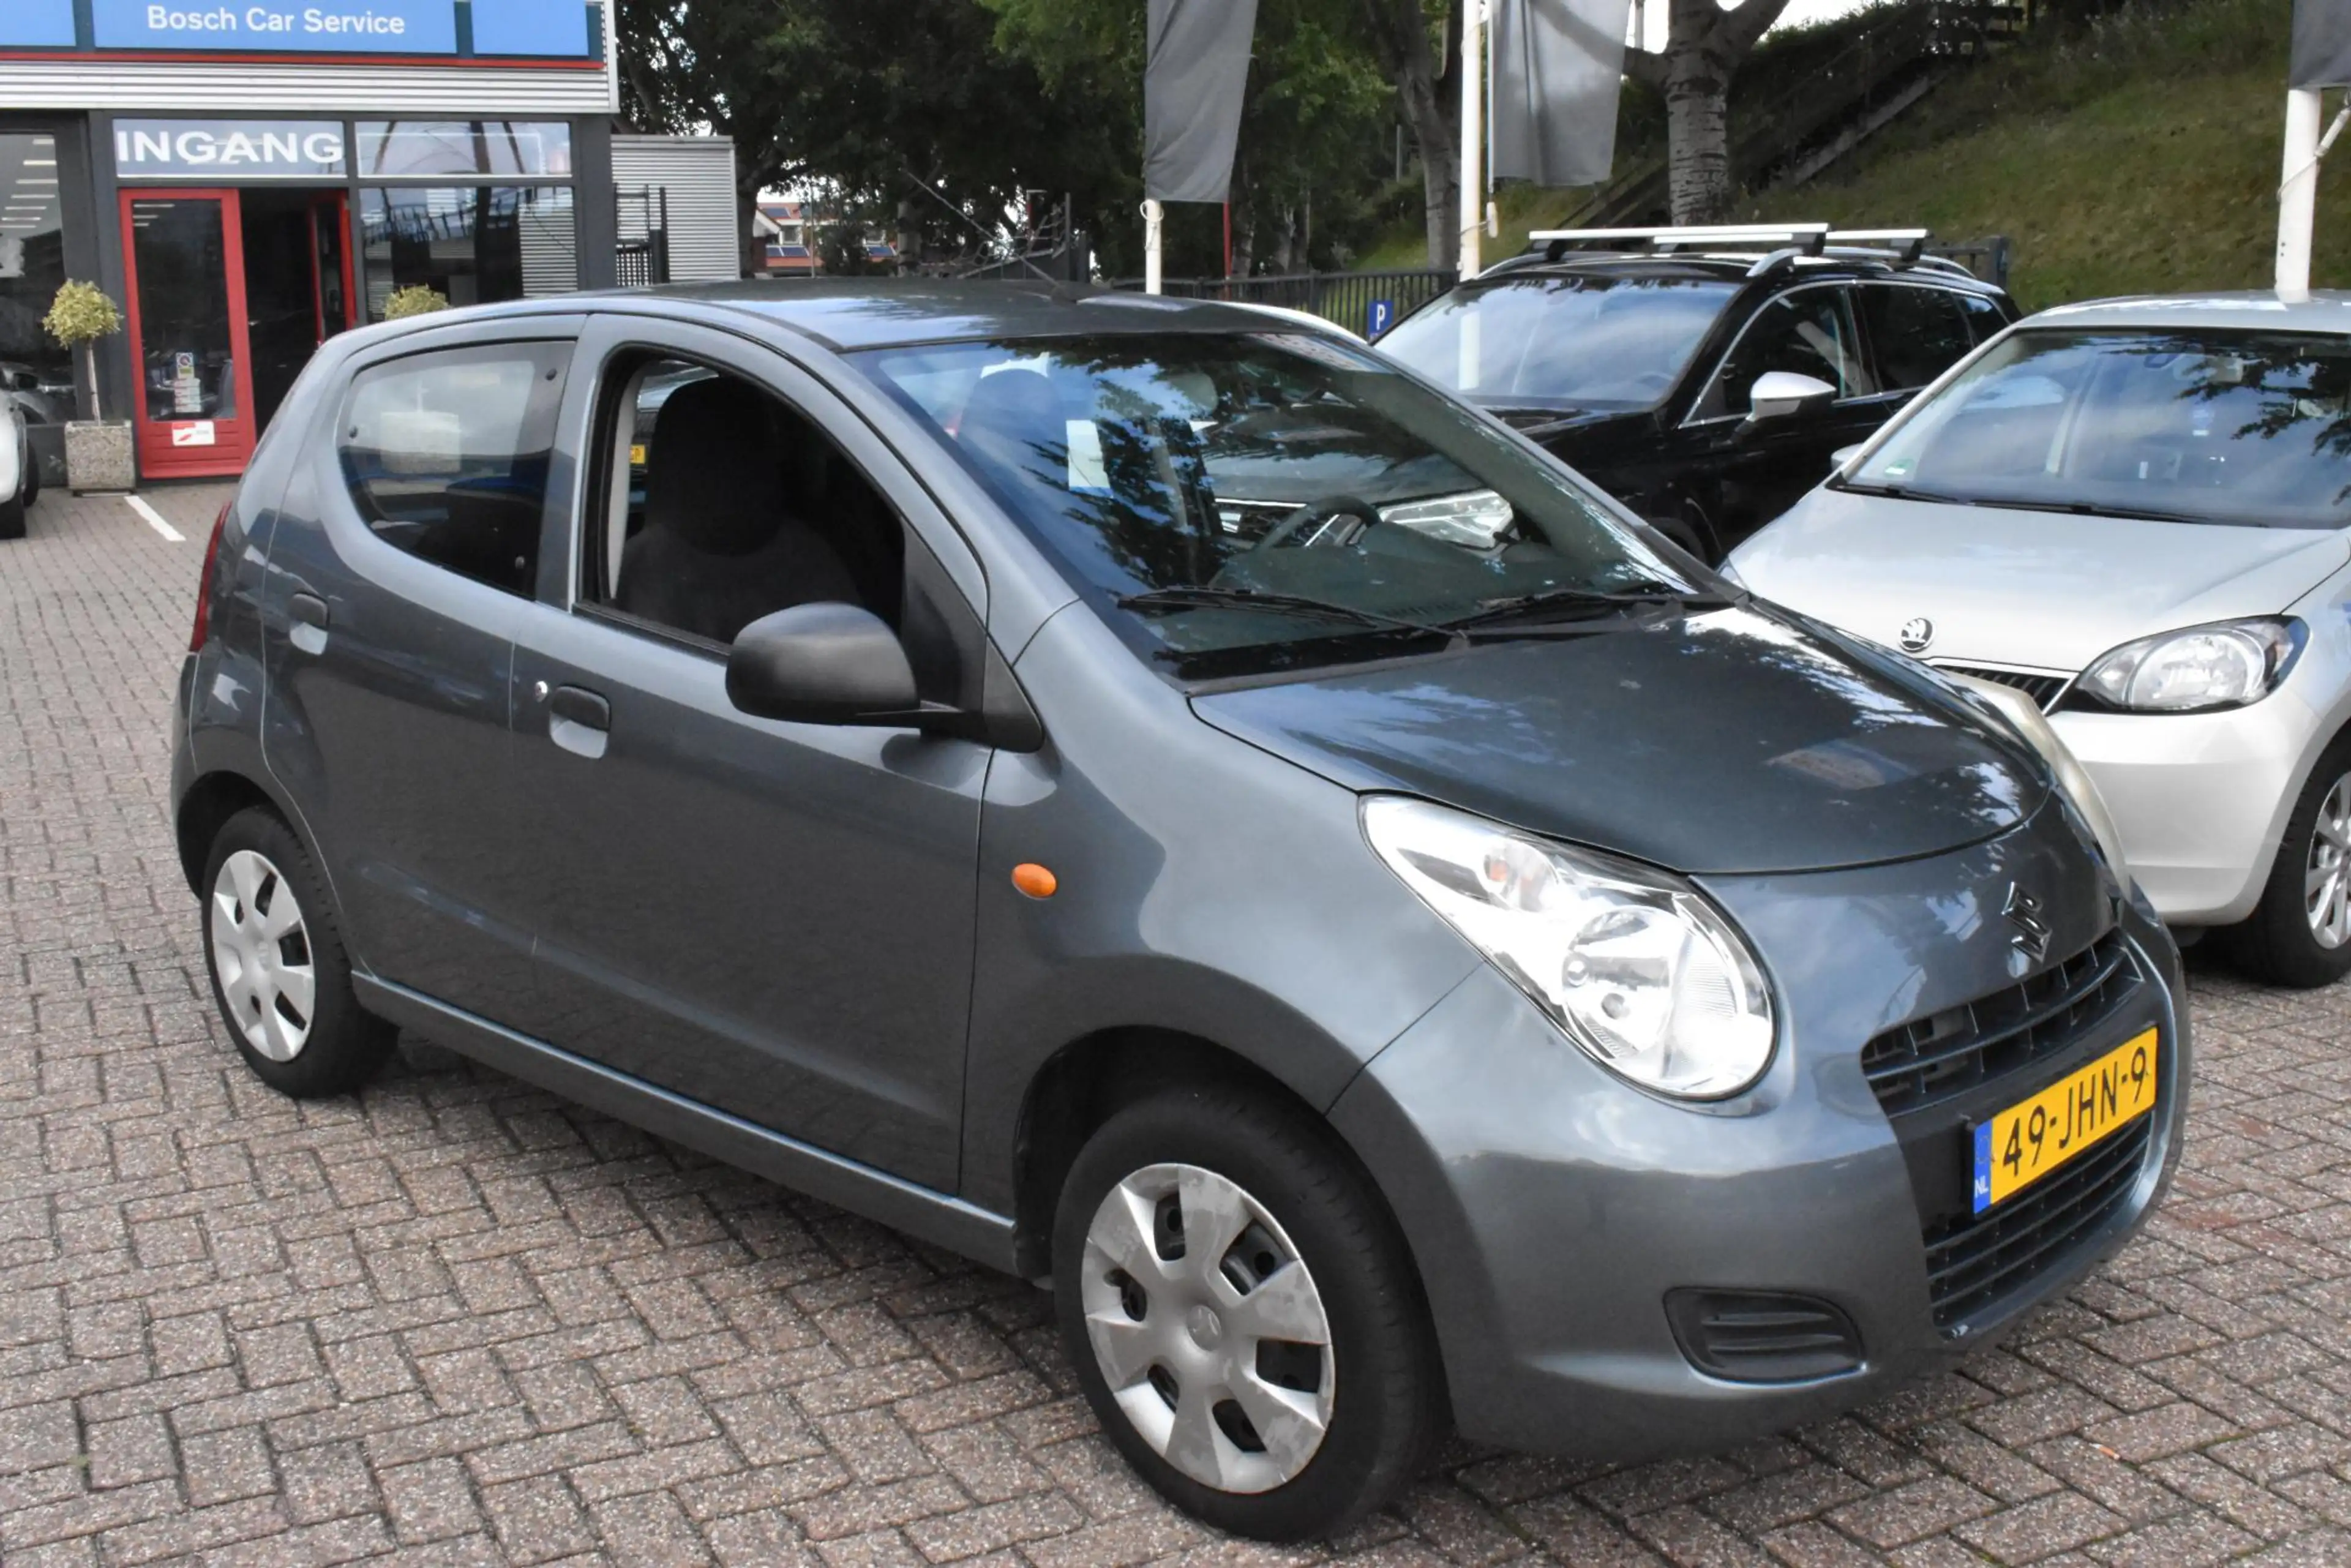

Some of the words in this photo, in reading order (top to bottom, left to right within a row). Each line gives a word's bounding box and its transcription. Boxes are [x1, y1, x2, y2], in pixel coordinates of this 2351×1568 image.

[147, 4, 237, 31] Bosch
[246, 7, 294, 31] Car
[304, 9, 405, 34] Service
[116, 130, 344, 163] INGANG
[1376, 303, 1386, 331] P
[2002, 1046, 2147, 1177] 49-JHN-9
[1974, 1175, 1989, 1198] NL
